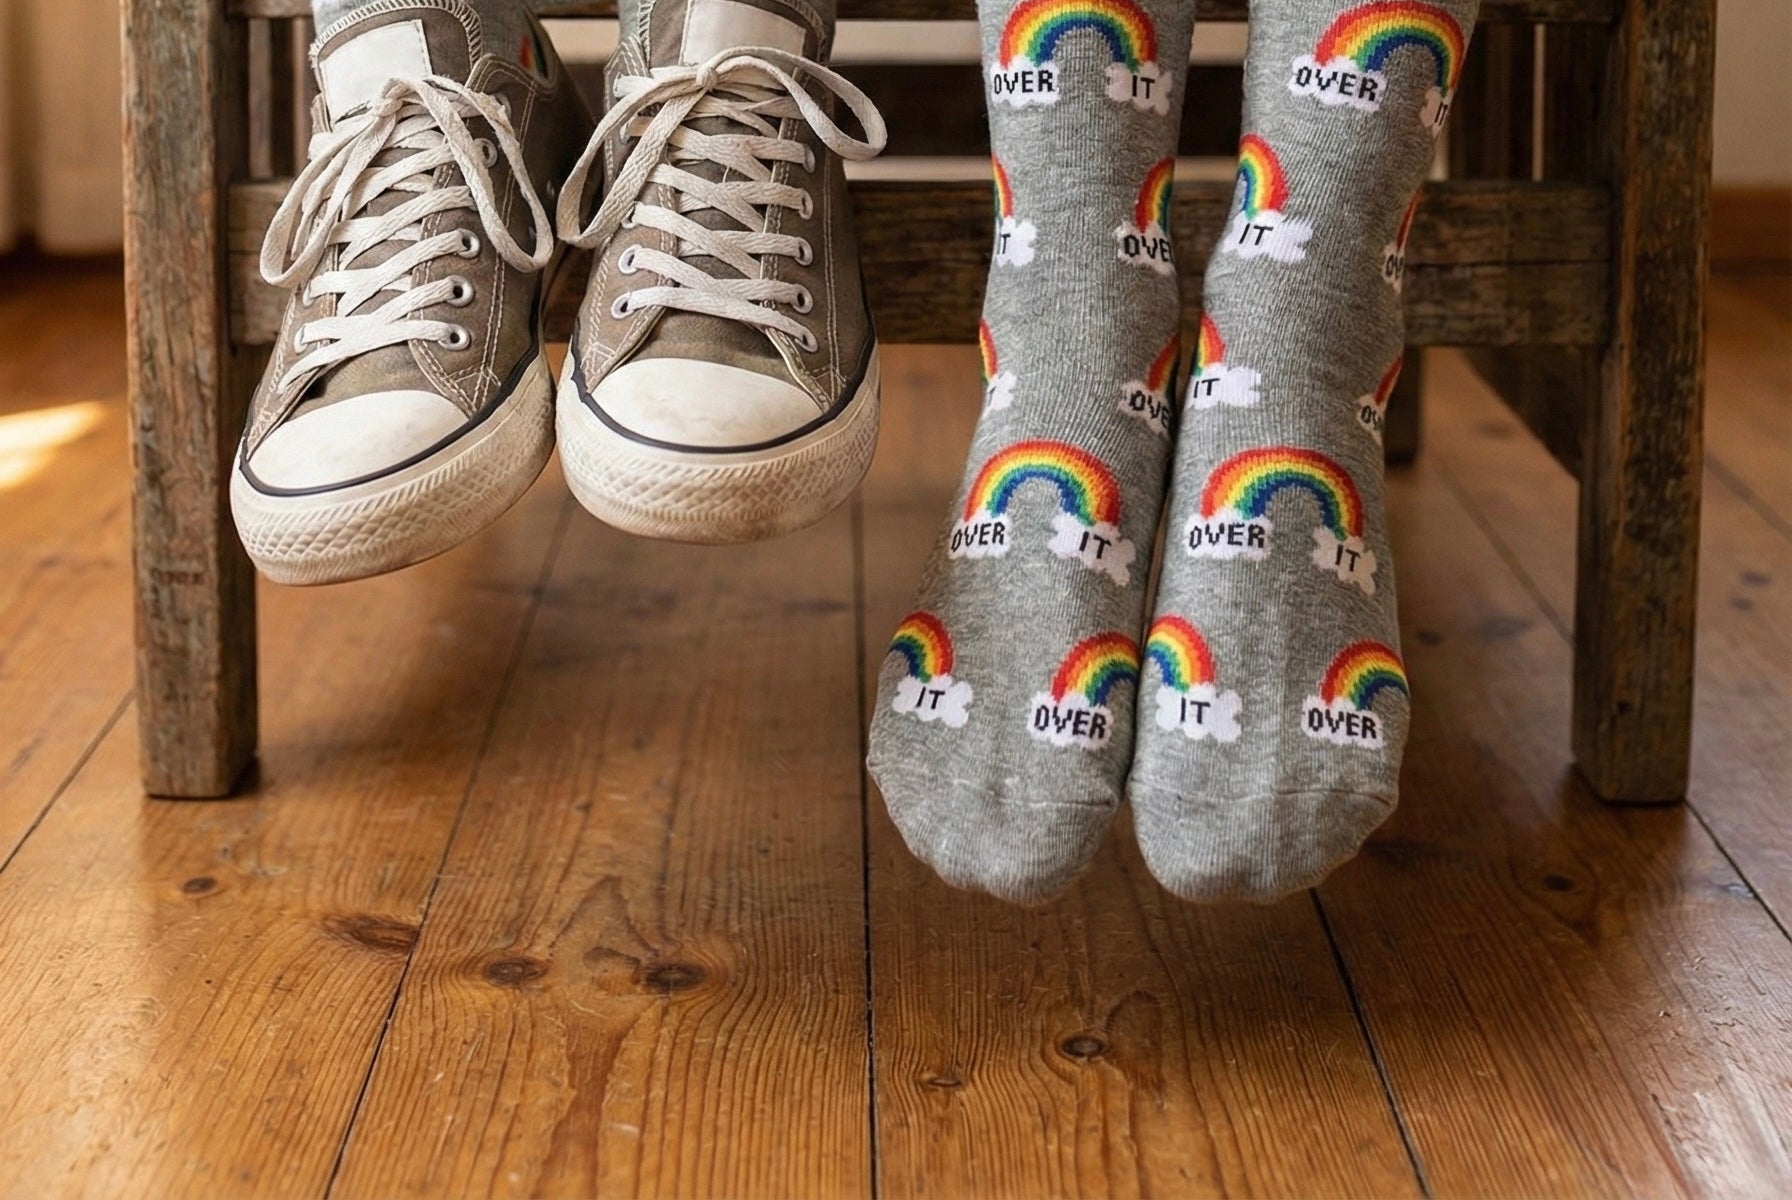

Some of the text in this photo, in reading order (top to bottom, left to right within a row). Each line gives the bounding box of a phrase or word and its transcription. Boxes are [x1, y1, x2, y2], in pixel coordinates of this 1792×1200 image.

[993, 69, 1156, 99] OVER IT
[1296, 66, 1449, 126] OVER IT
[1123, 234, 1172, 262] OVE
[1238, 223, 1274, 246] IT
[1193, 378, 1220, 398] IT
[1129, 390, 1170, 428] OVE
[951, 522, 1112, 560] OVER IT
[1189, 523, 1362, 572] OVER IT
[916, 686, 946, 710] IT
[1180, 698, 1211, 725] IT
[1034, 705, 1106, 740] OVER
[1308, 707, 1378, 740] OVER
